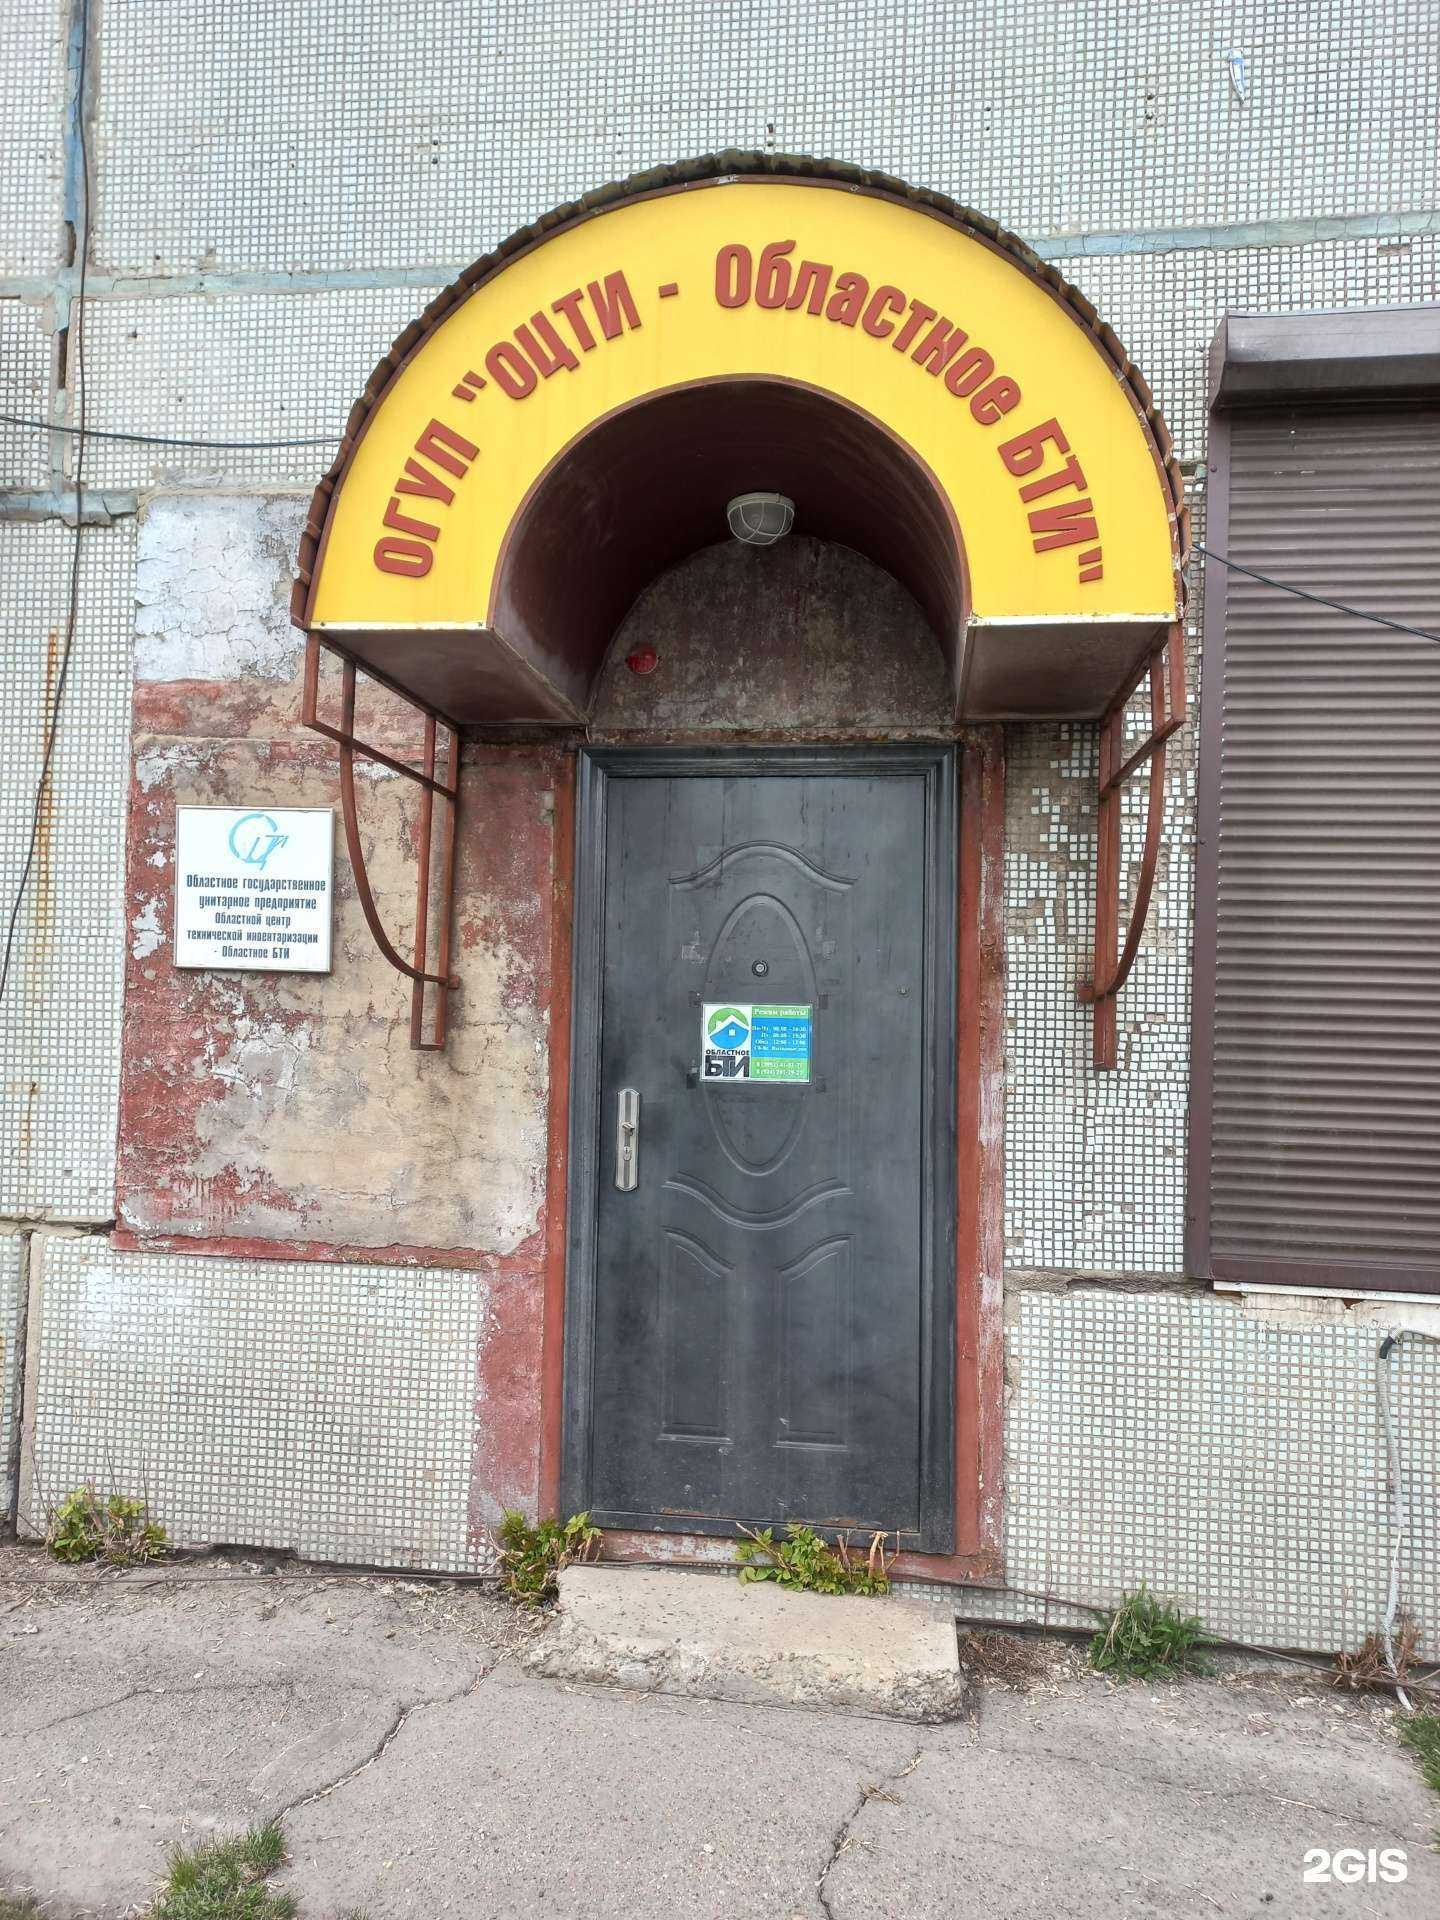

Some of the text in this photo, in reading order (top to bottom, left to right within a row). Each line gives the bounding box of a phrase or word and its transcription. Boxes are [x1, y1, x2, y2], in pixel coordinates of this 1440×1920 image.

[373, 239, 1104, 584] ОГУП "ОЦТИ - Областное БТИ"
[186, 874, 326, 893] Областное государственное
[199, 895, 317, 911] унитарное предприятие
[215, 912, 291, 928] Областной центр
[187, 929, 242, 941] технической
[222, 945, 268, 959] Областное
[272, 946, 290, 959] БТИ
[704, 1055, 750, 1078] БТИ
